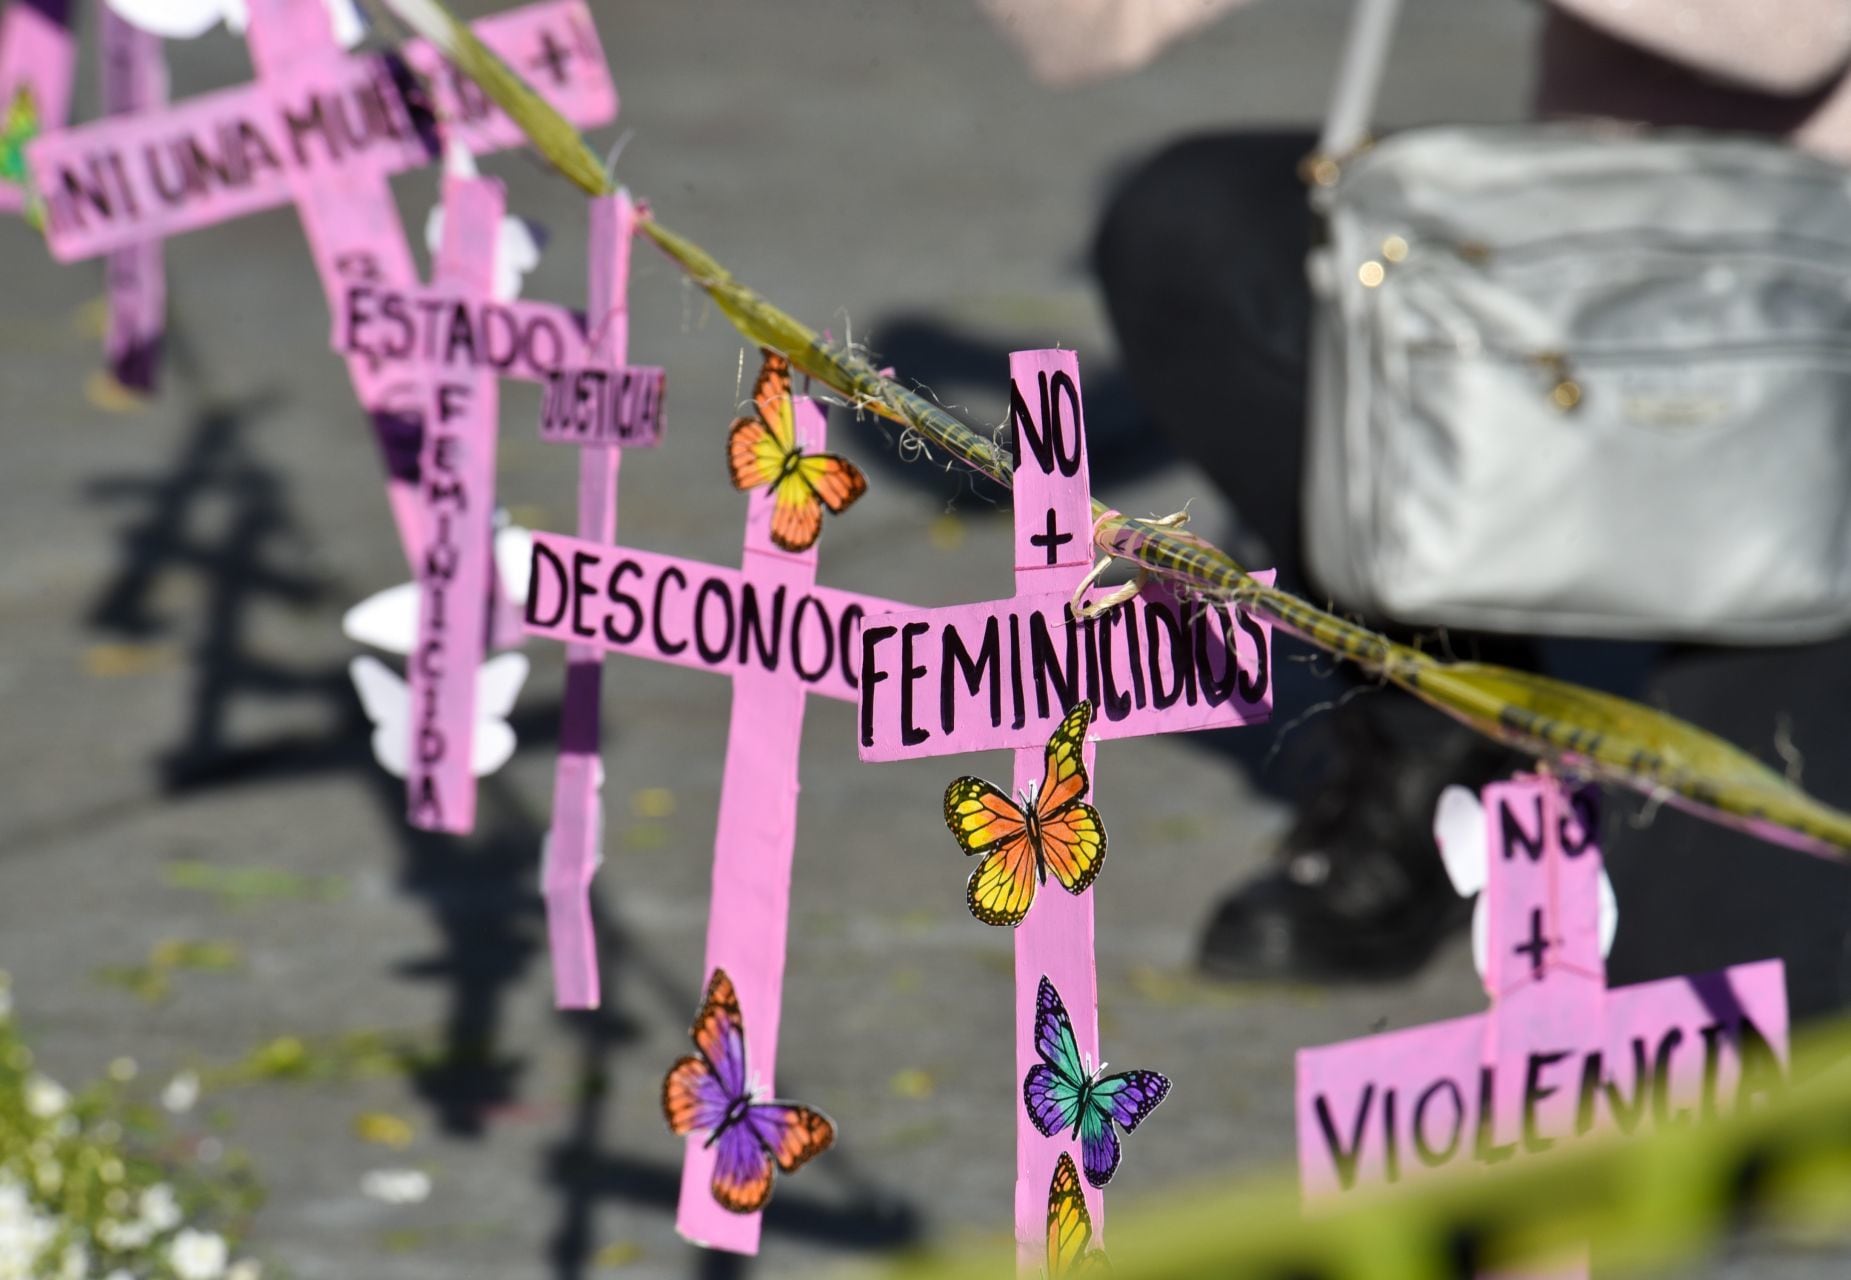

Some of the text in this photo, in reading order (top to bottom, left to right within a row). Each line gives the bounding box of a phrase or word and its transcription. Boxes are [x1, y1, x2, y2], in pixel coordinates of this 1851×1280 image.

[347, 286, 566, 374] ESTADO
[1010, 370, 1082, 477] NO
[525, 541, 865, 690] DESCONOC
[861, 598, 1268, 747] FEMINICIDIOS
[1501, 787, 1599, 862] NO
[1314, 1014, 1787, 1191] VIOLENCIA
